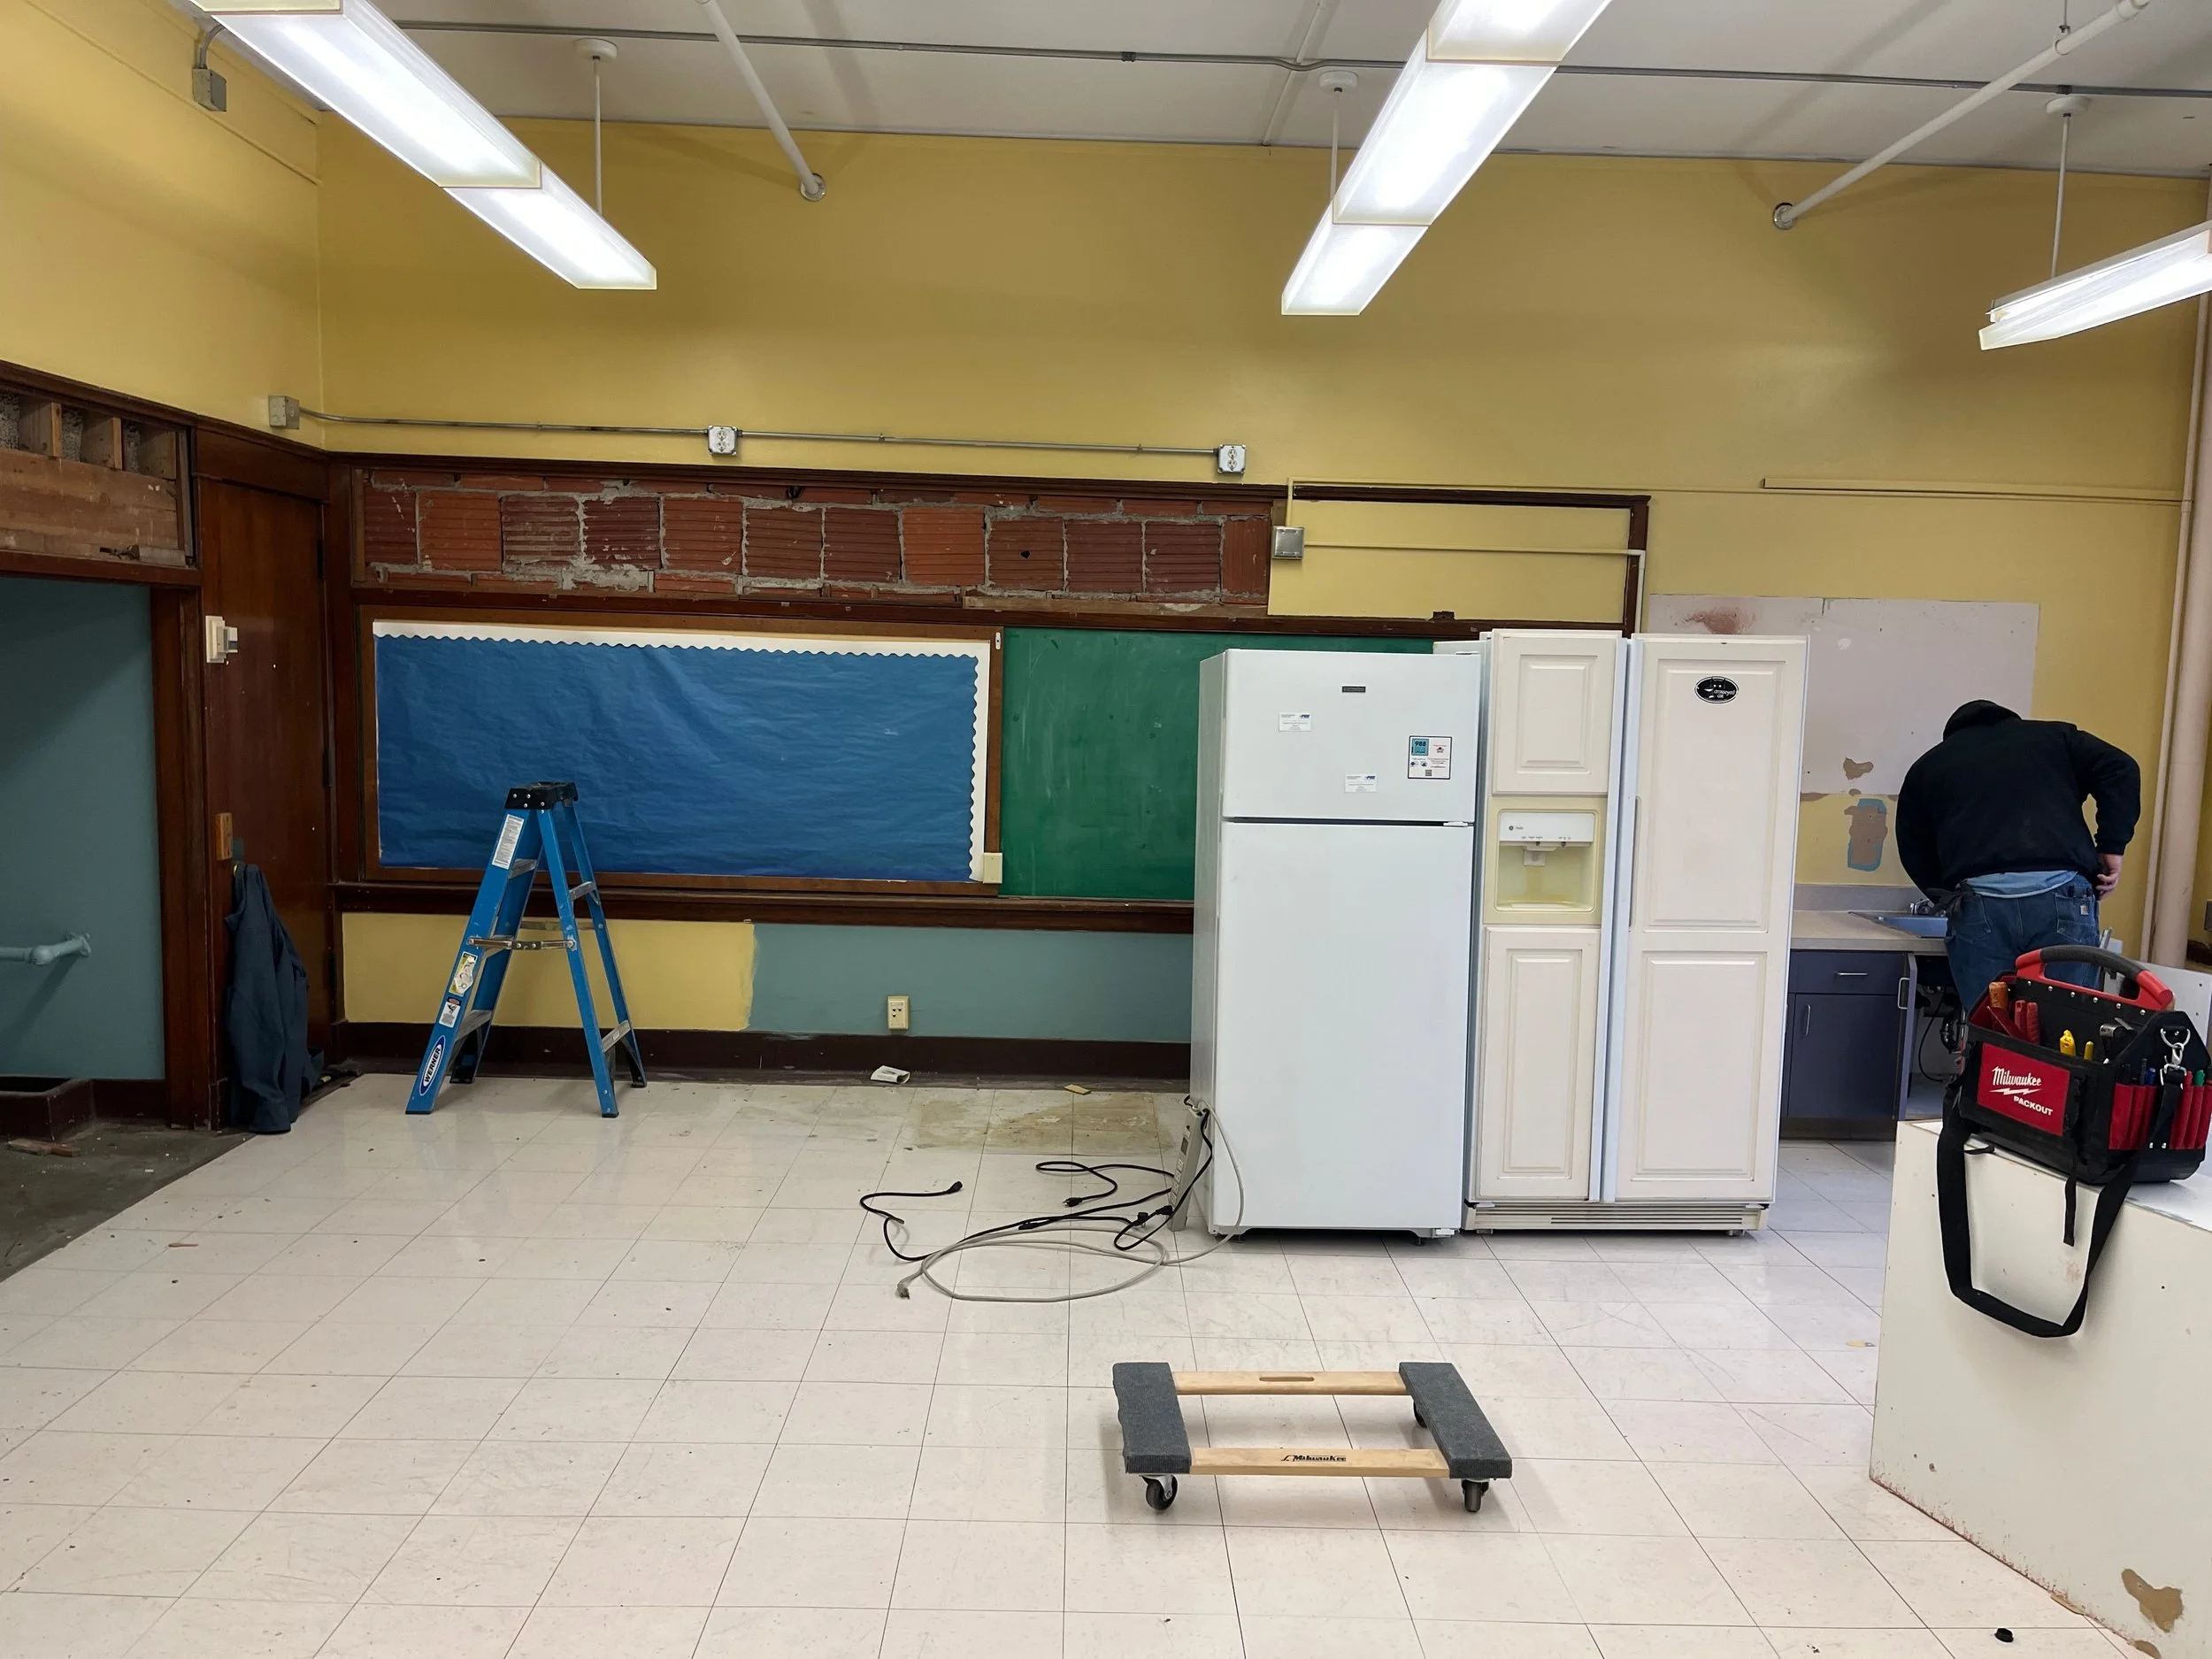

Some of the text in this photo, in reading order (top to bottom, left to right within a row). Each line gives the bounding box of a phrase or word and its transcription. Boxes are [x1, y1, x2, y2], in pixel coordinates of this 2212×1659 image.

[424, 1047, 441, 1082] WERNER
[1991, 1065, 2042, 1087] Milwaukee
[2013, 1095, 2054, 1116] PACKOUT
